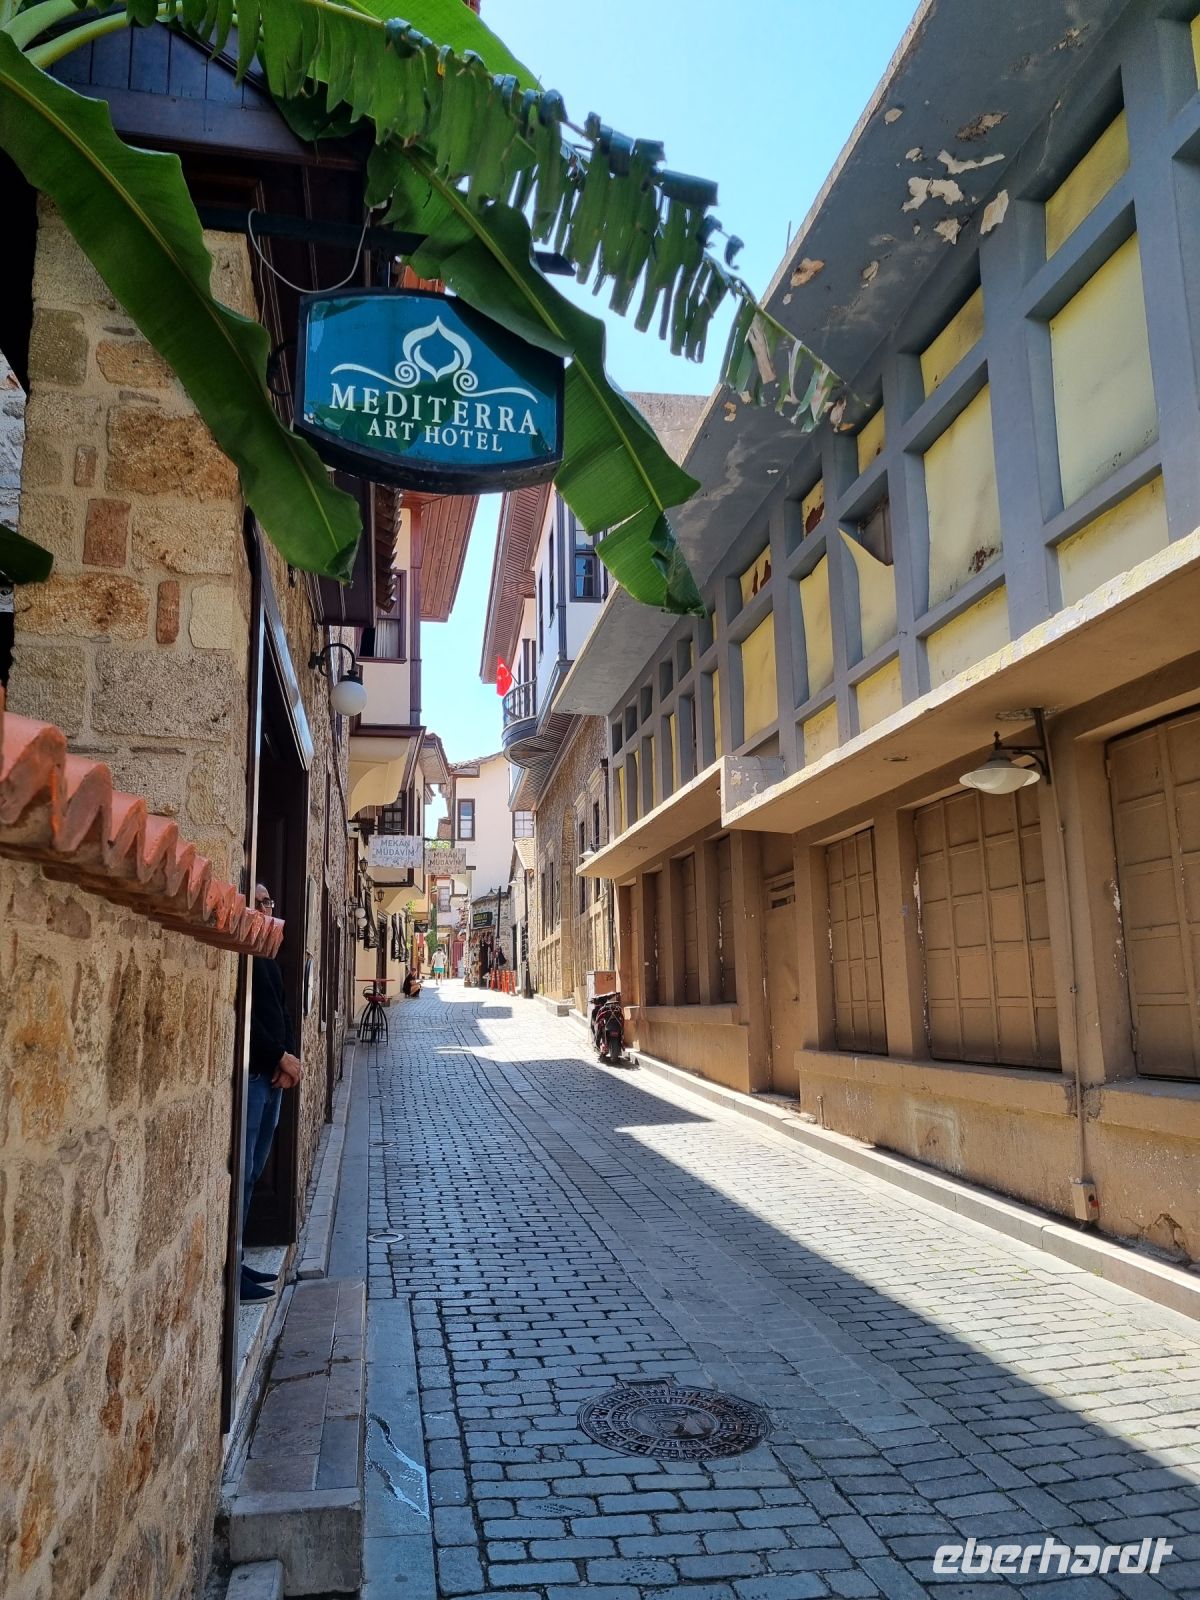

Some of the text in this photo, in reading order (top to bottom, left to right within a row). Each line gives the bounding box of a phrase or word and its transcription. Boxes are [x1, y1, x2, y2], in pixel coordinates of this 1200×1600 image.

[329, 383, 538, 436] MEDITERRA
[367, 418, 503, 452] ART HOTEL
